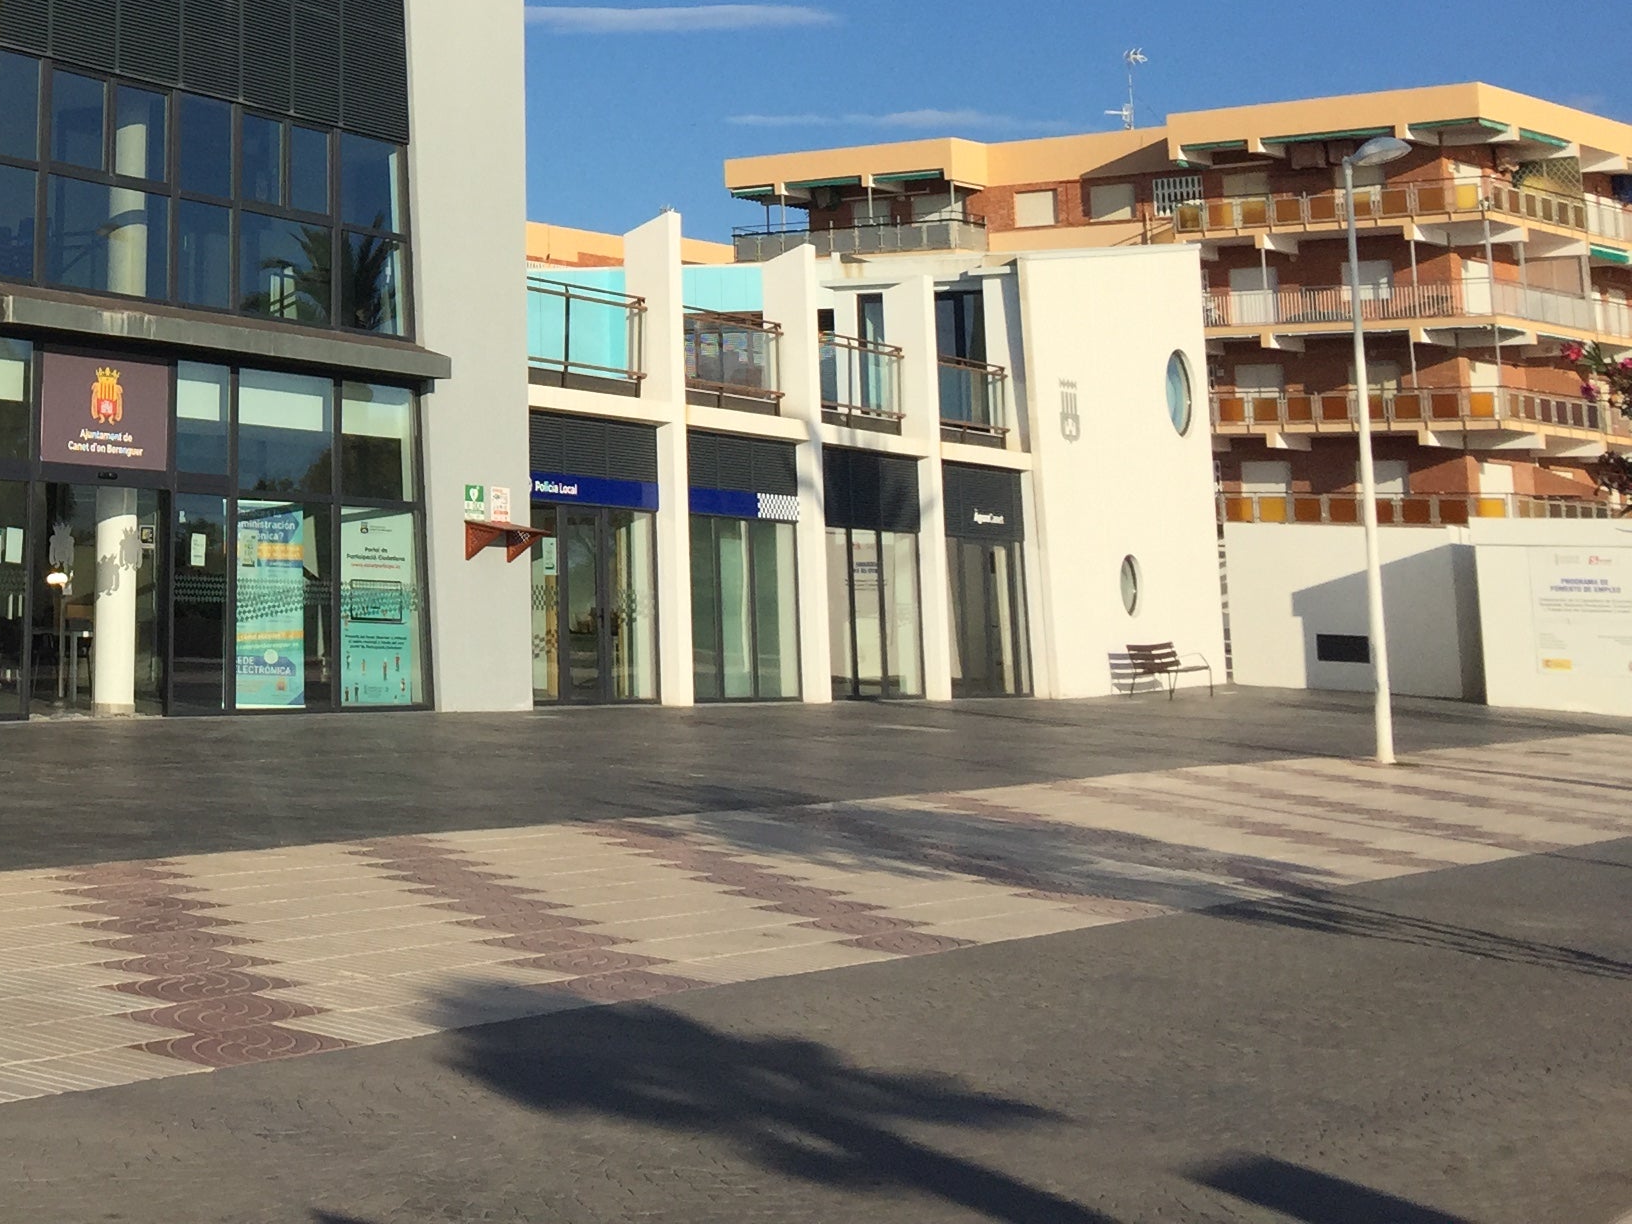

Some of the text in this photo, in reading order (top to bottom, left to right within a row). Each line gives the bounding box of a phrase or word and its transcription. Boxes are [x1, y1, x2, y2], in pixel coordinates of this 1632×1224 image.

[79, 428, 133, 443] Ajuntament de
[67, 440, 90, 452] Canet
[106, 444, 144, 458] Berenguer
[559, 482, 578, 495] Local
[237, 519, 296, 530] ministración
